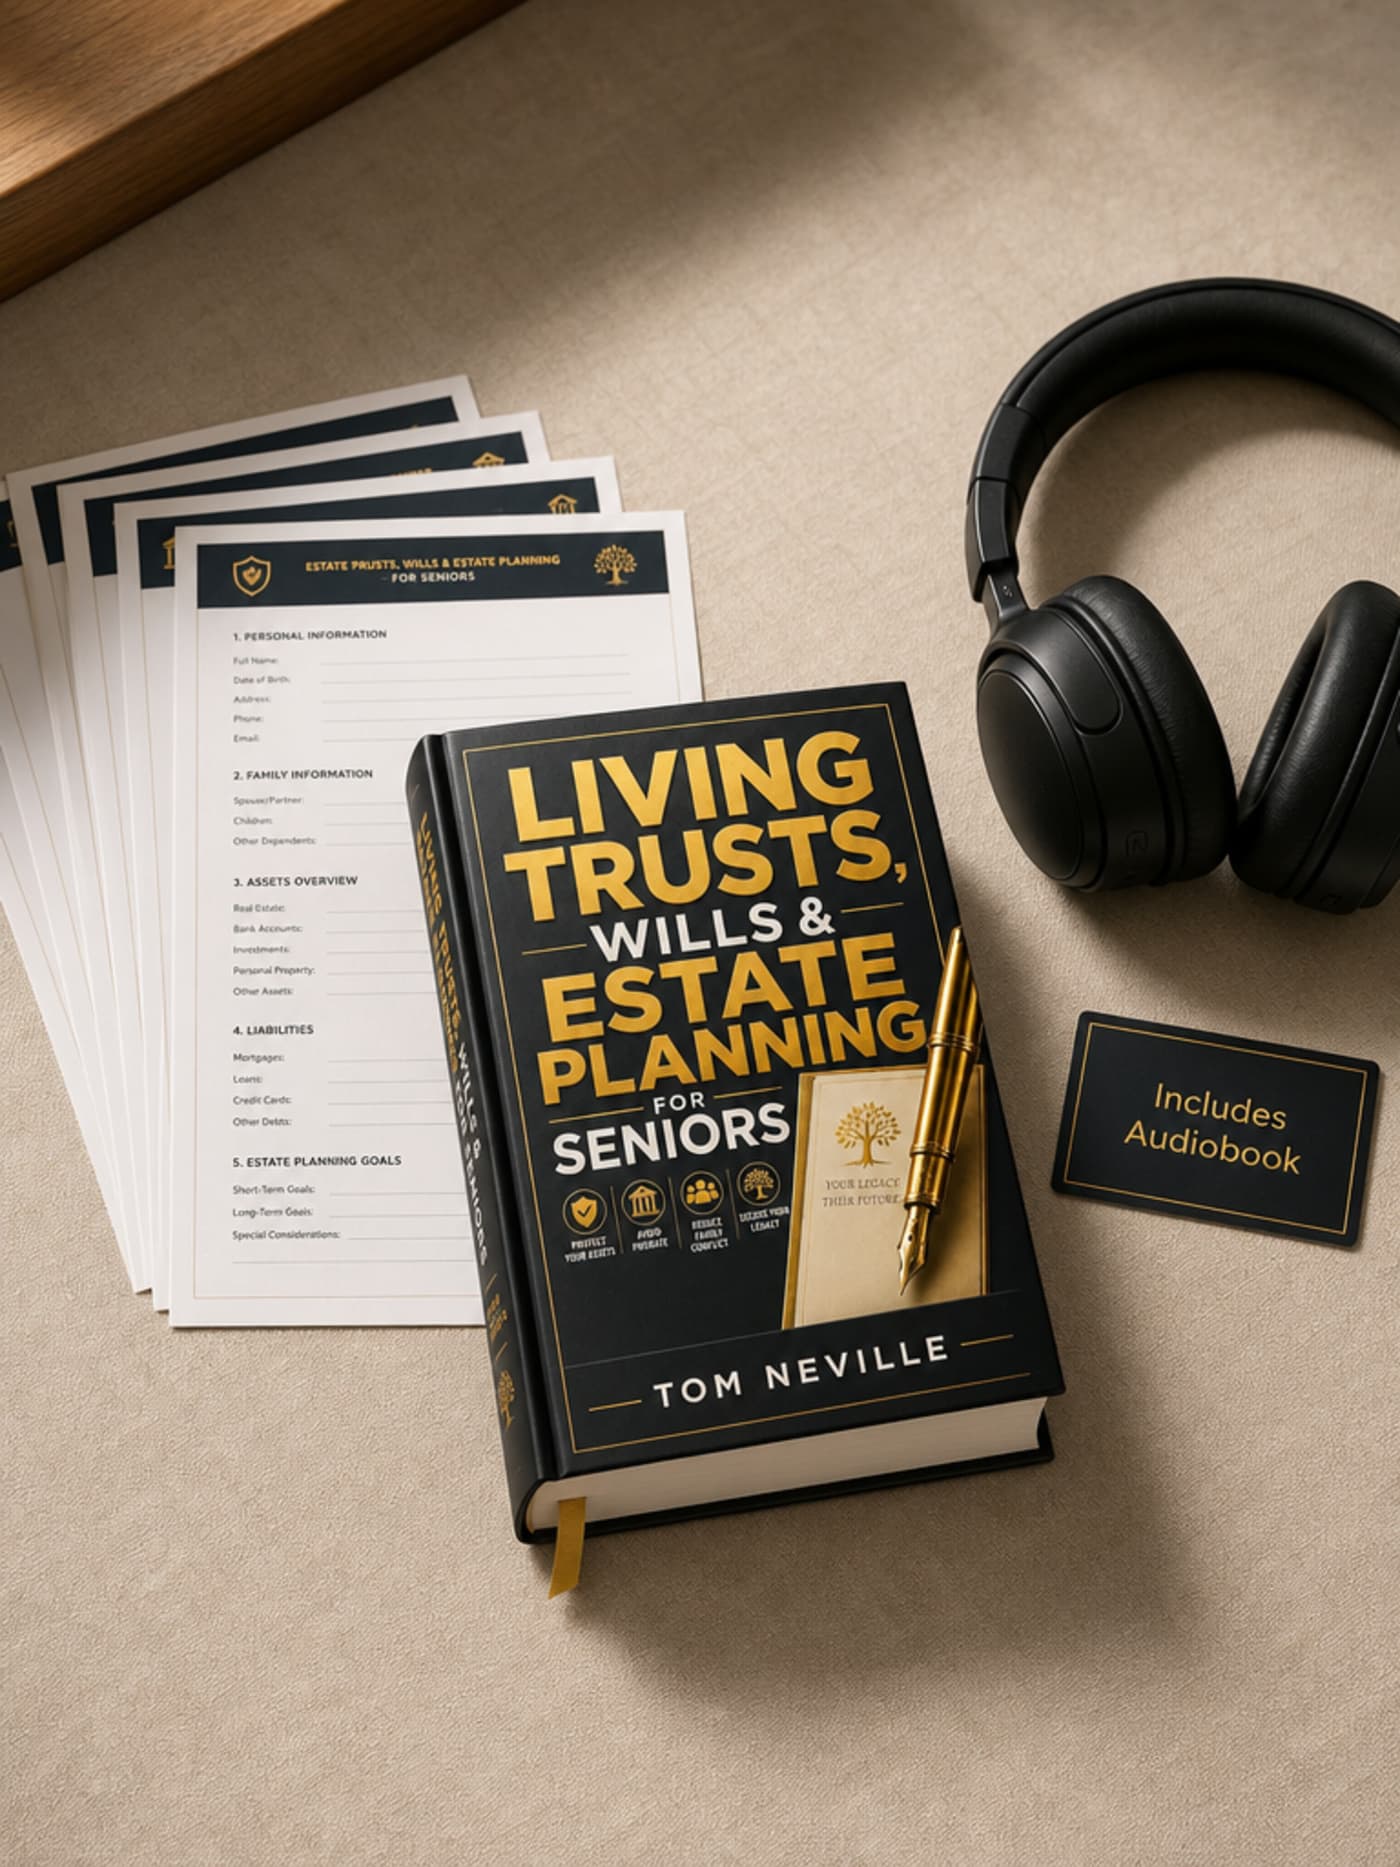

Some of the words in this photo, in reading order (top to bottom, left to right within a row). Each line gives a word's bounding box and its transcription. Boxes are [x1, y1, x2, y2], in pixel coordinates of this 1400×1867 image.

[305, 561, 348, 572] ESTATE
[403, 559, 439, 570] WILLS
[442, 558, 450, 569] &
[453, 557, 495, 569] ESTATE
[499, 554, 561, 567] PLANNING
[391, 573, 416, 583] FOR
[421, 571, 475, 583] SENIORS
[233, 633, 241, 641] 1.
[244, 632, 304, 641] PERSONAL
[307, 630, 387, 640] INFORMATION
[233, 657, 249, 665] Full
[233, 676, 254, 684] Date
[256, 676, 265, 684] of
[233, 772, 243, 781] 2.
[246, 771, 288, 780] FAMILY
[291, 769, 373, 779] INFORMATION
[508, 731, 874, 842] LIVING
[233, 837, 258, 846] Other
[504, 809, 907, 922] TRUSTS,
[246, 876, 290, 887] ASSETS
[294, 876, 358, 886] OVERVIEW
[233, 904, 253, 913] Real
[233, 925, 255, 933] Bank
[589, 903, 783, 962] WILLS
[800, 897, 834, 935] &
[233, 966, 272, 975] Personal
[233, 987, 259, 996] Other
[542, 932, 905, 1043] ESTATE
[233, 1026, 243, 1035] 4.
[247, 1024, 314, 1035] LIABILITIES
[537, 1001, 928, 1105] PLANNING
[233, 1096, 261, 1105] Credit
[653, 1091, 706, 1115] FOR
[1154, 1083, 1287, 1130] Includes
[232, 1117, 259, 1126] Other
[553, 1102, 791, 1176] SENIORS
[1123, 1120, 1302, 1175] Audiobook
[233, 1157, 243, 1167] 5.
[247, 1157, 290, 1167] ESTATE
[294, 1156, 357, 1167] PLANNING
[360, 1155, 402, 1166] GOALS
[232, 1185, 285, 1195] Short-Term
[232, 1208, 283, 1218] Long-Term
[232, 1230, 266, 1241] Special
[654, 1371, 742, 1407] TOM
[765, 1335, 948, 1390] NEVILLE
